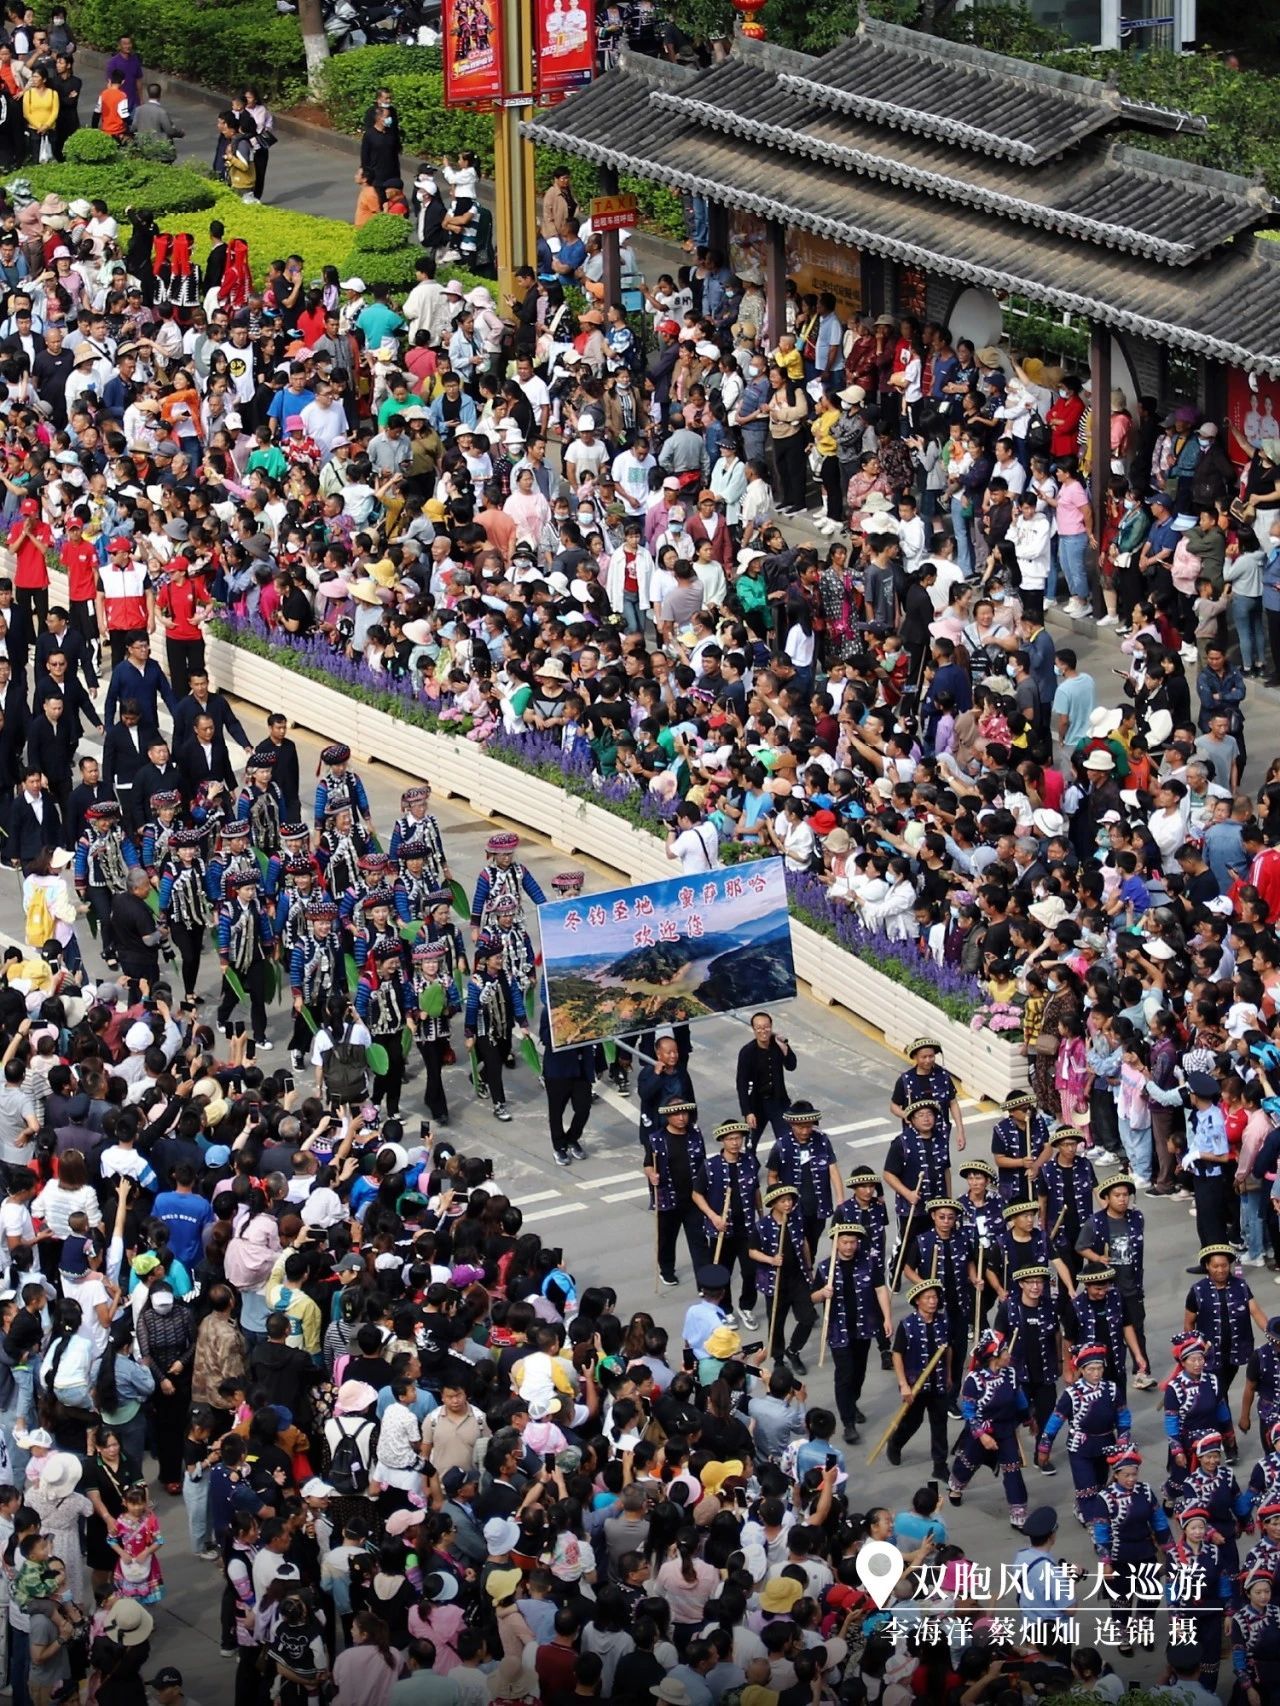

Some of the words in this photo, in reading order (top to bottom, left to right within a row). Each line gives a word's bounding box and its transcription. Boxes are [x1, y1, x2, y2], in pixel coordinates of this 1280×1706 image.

[594, 196, 634, 213] TAXI
[564, 896, 654, 931] 冬钓圣地
[634, 915, 704, 947] 欢迎您
